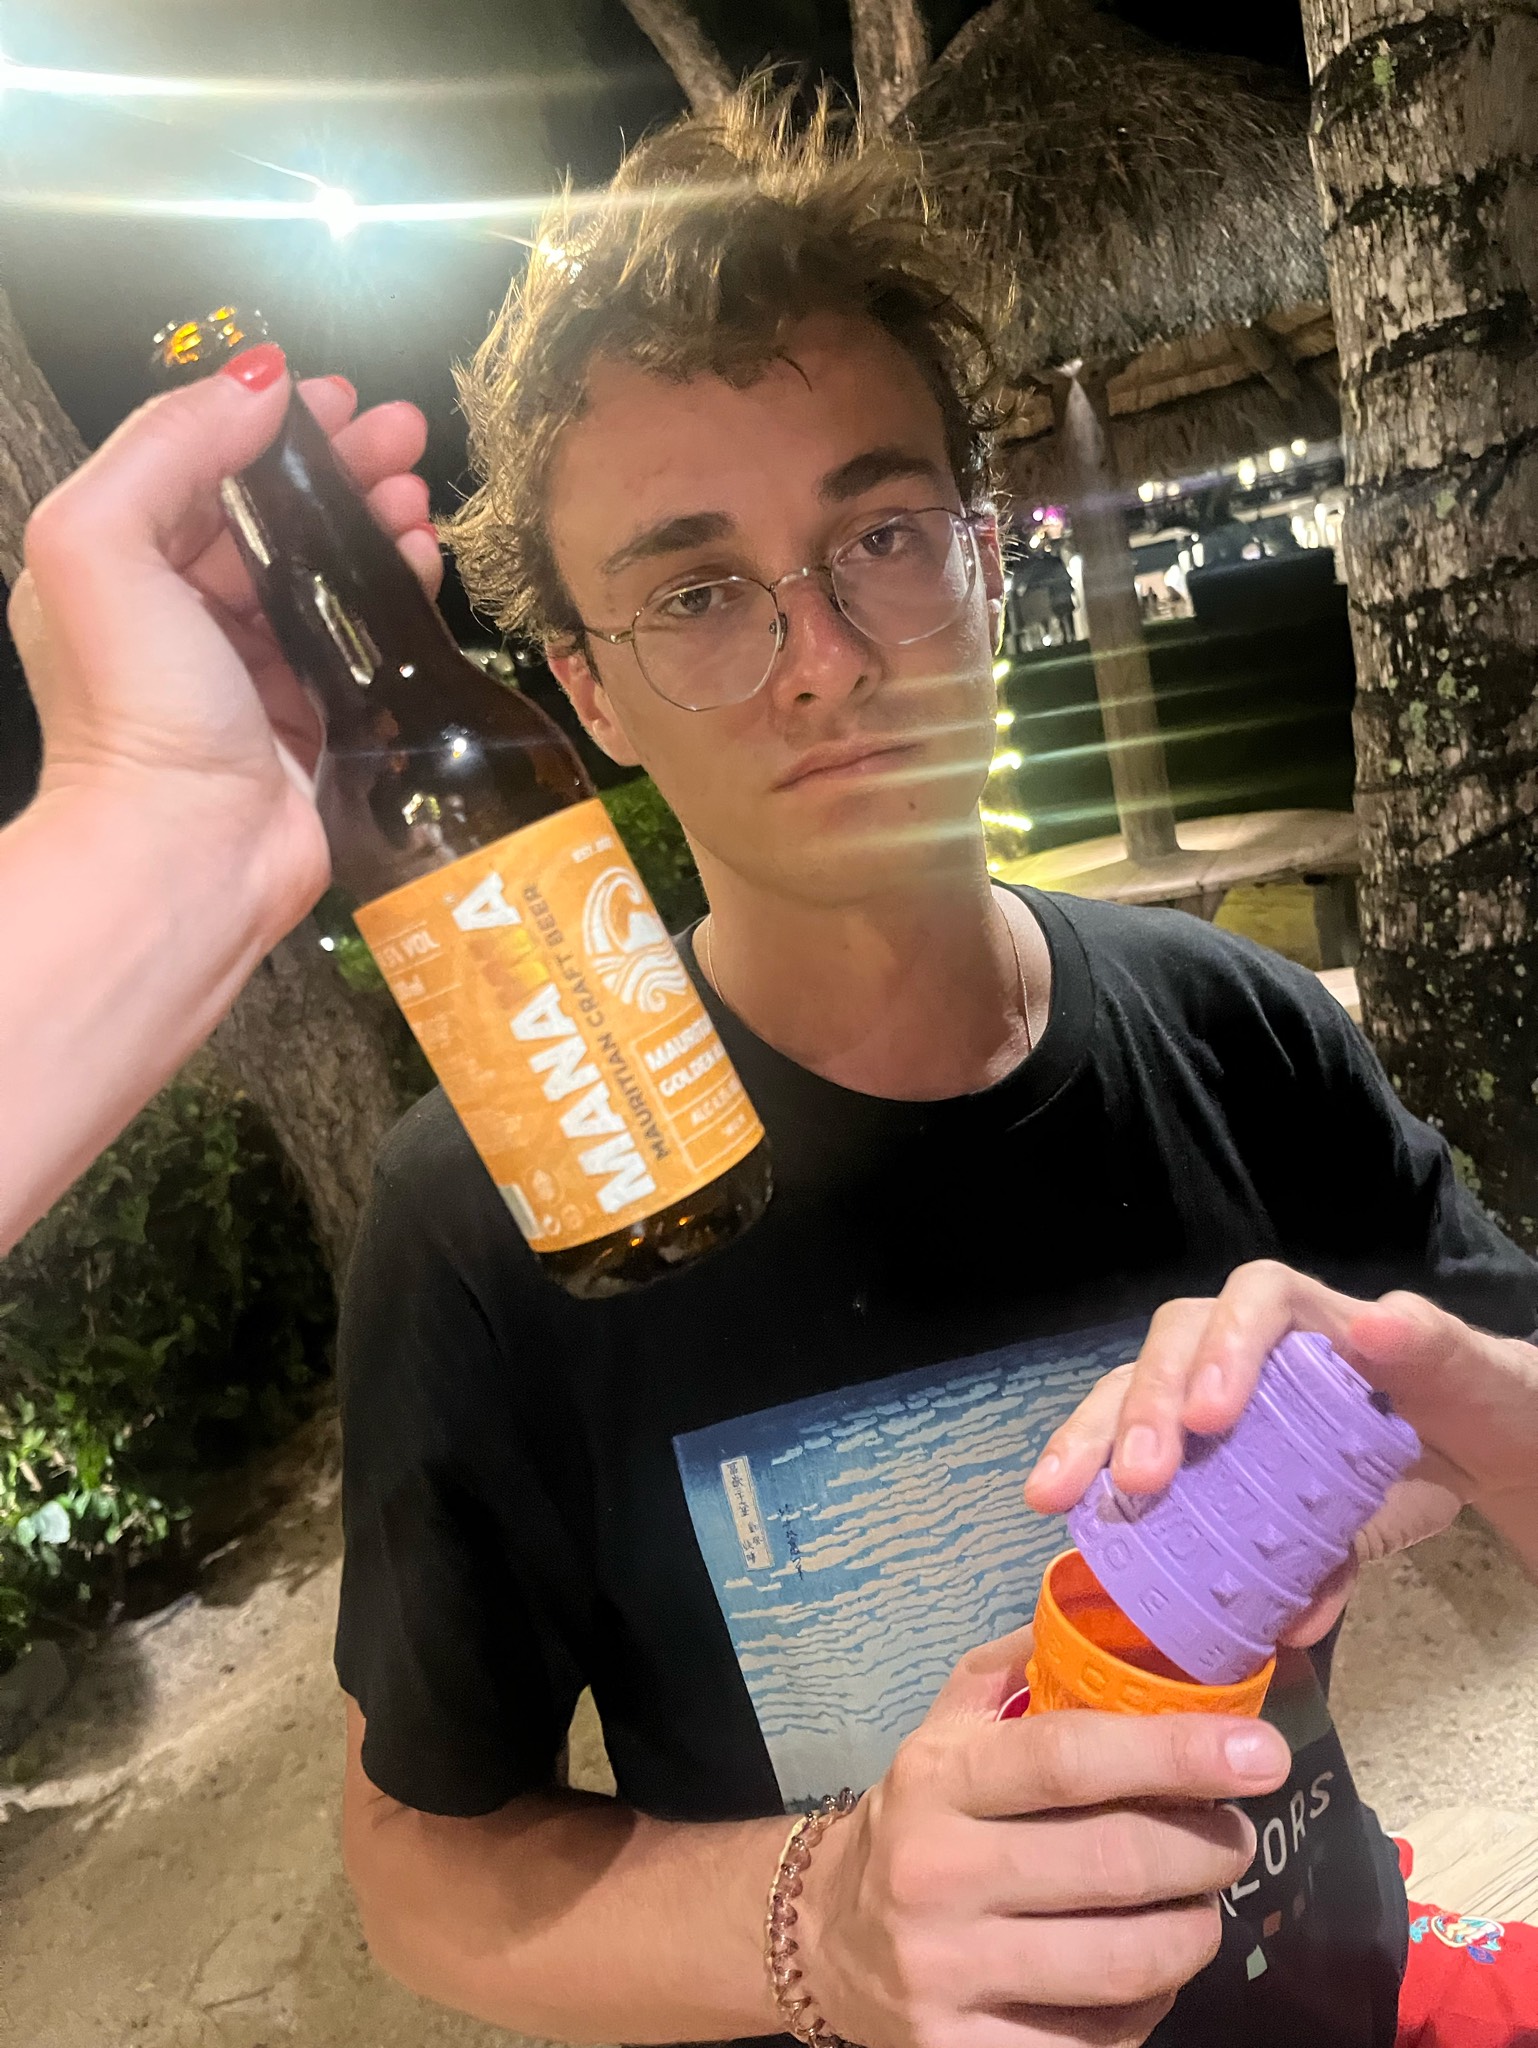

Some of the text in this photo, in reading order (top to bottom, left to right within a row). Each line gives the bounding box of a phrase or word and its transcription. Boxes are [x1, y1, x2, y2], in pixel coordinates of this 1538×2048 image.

[522, 884, 670, 1161] MAURITIAN CRAFT BEER
